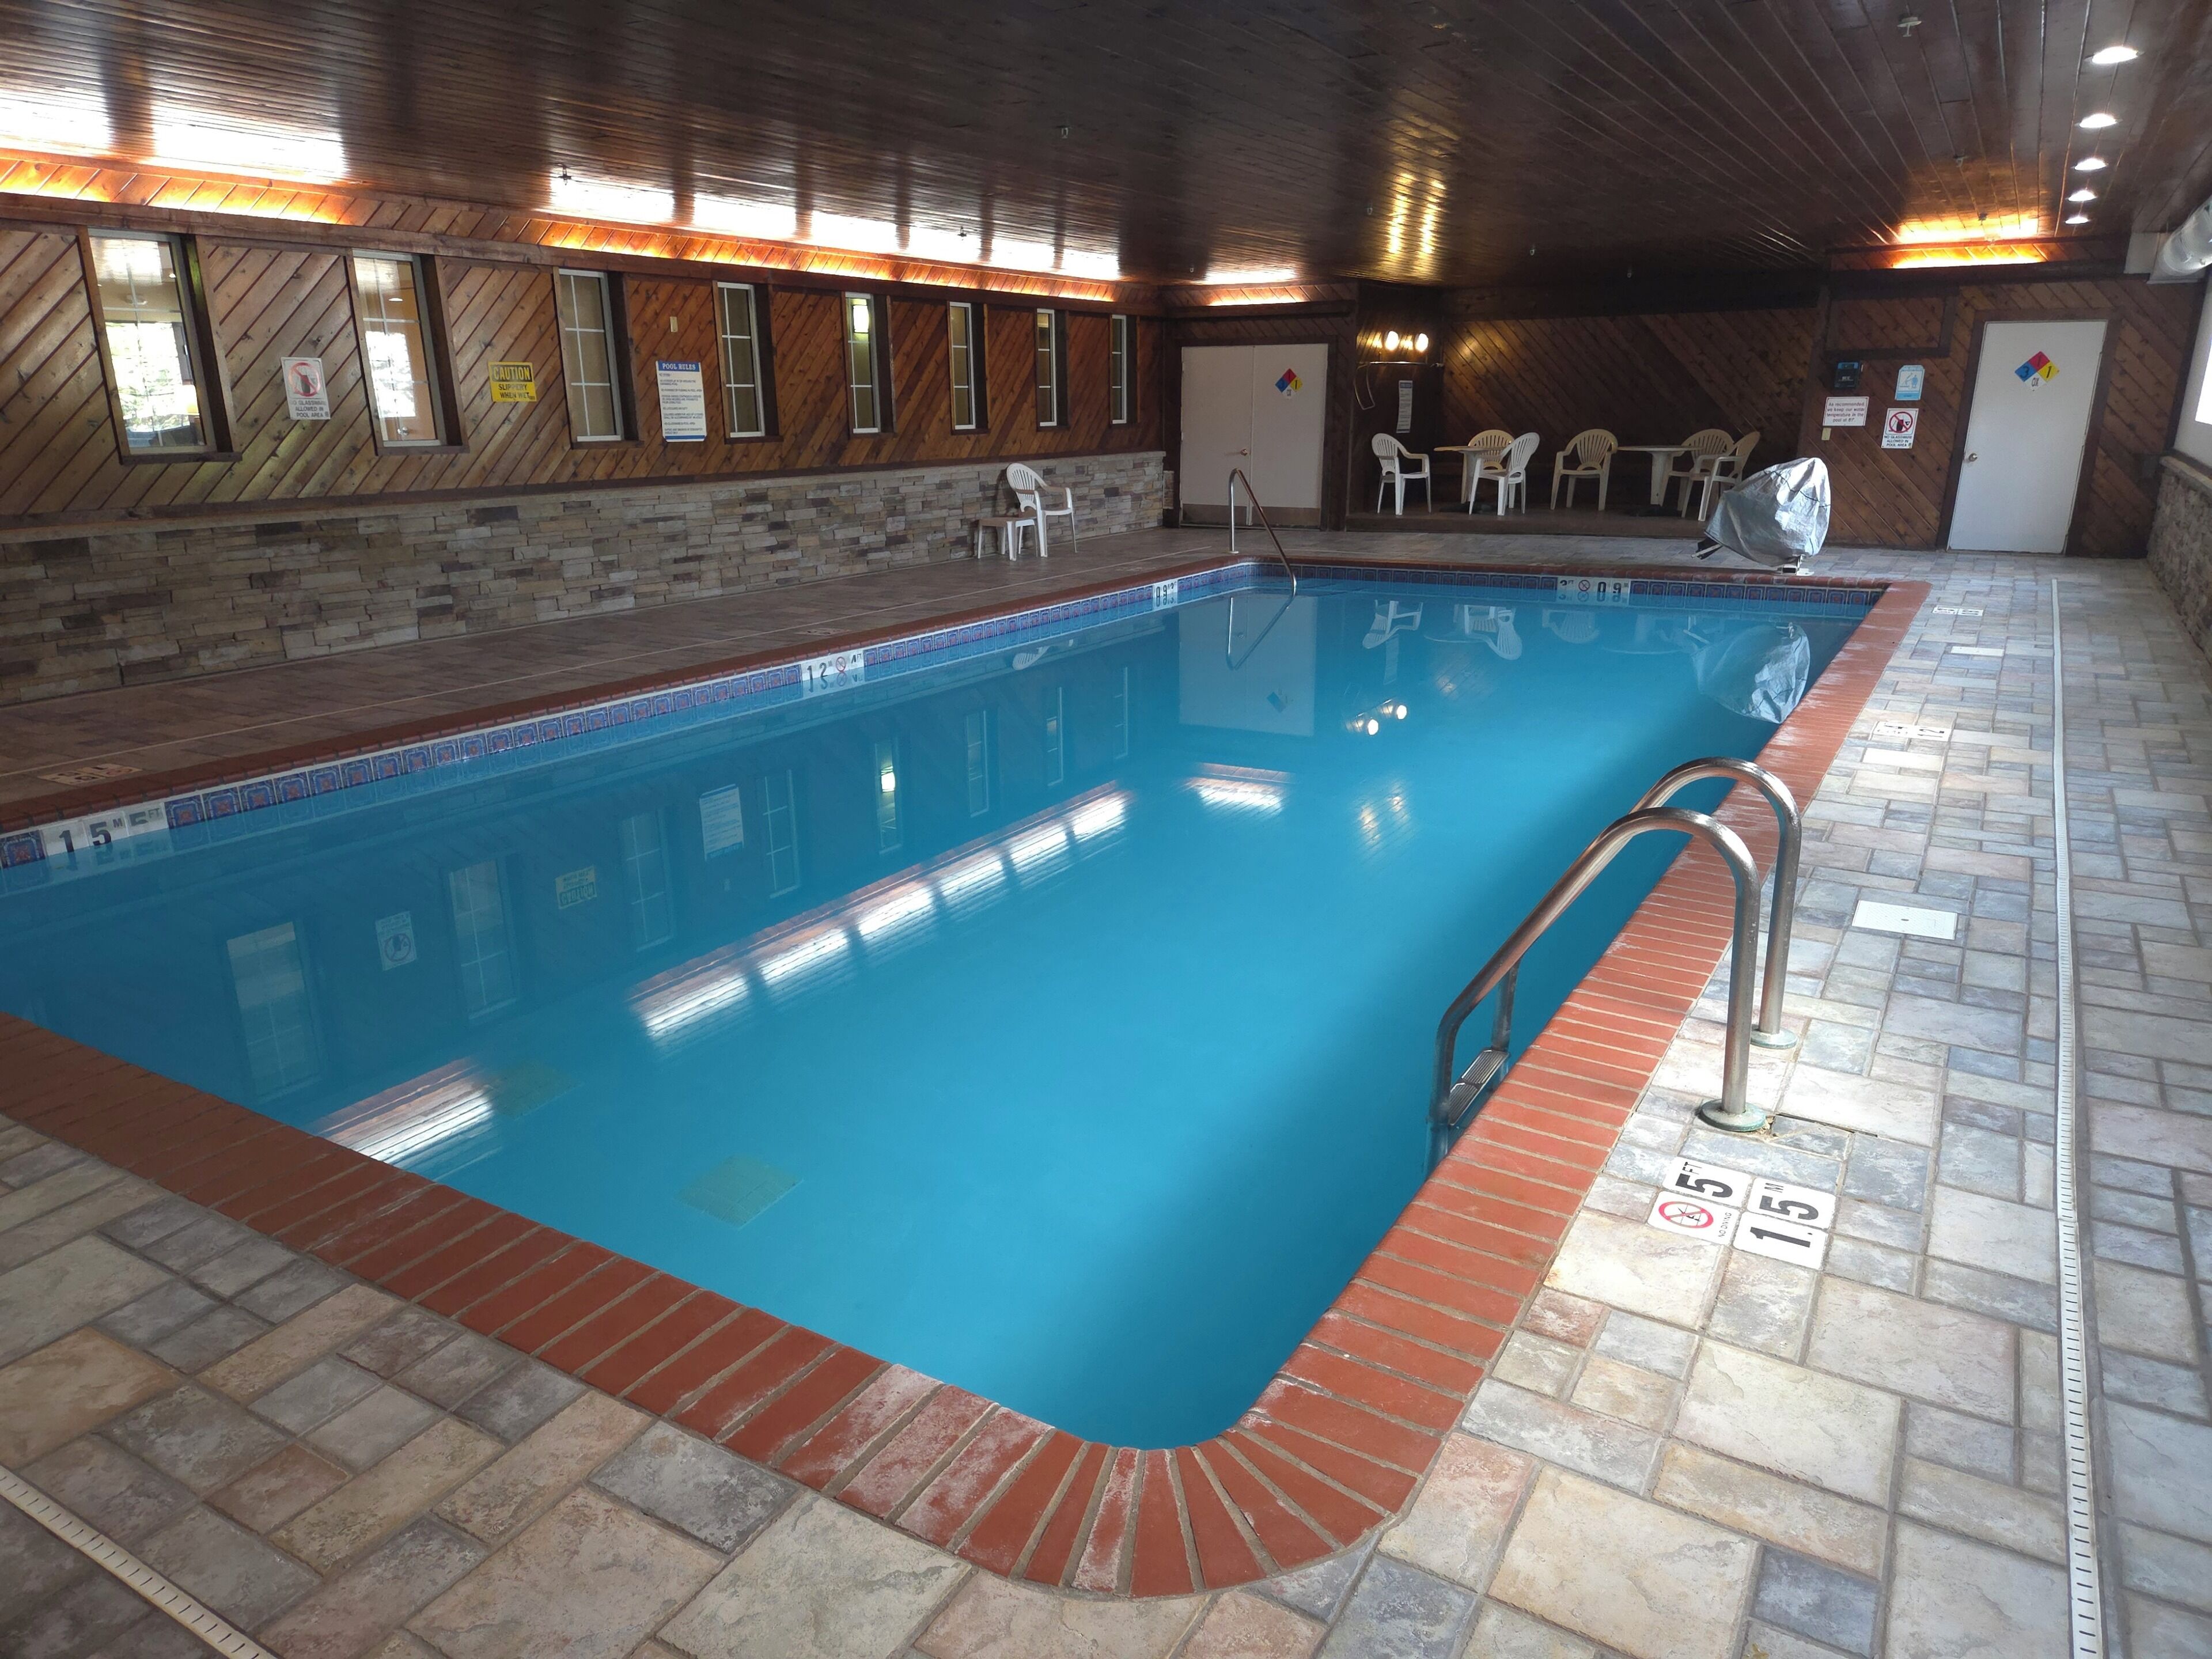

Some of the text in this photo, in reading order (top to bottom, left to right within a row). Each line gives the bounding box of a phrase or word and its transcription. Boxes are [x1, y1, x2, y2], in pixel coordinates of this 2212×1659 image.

[494, 366, 531, 380] CAUTION
[149, 808, 160, 819] FT
[113, 819, 122, 828] M
[1675, 1161, 1733, 1198] 5 FT
[1720, 1212, 1732, 1229] DIVING
